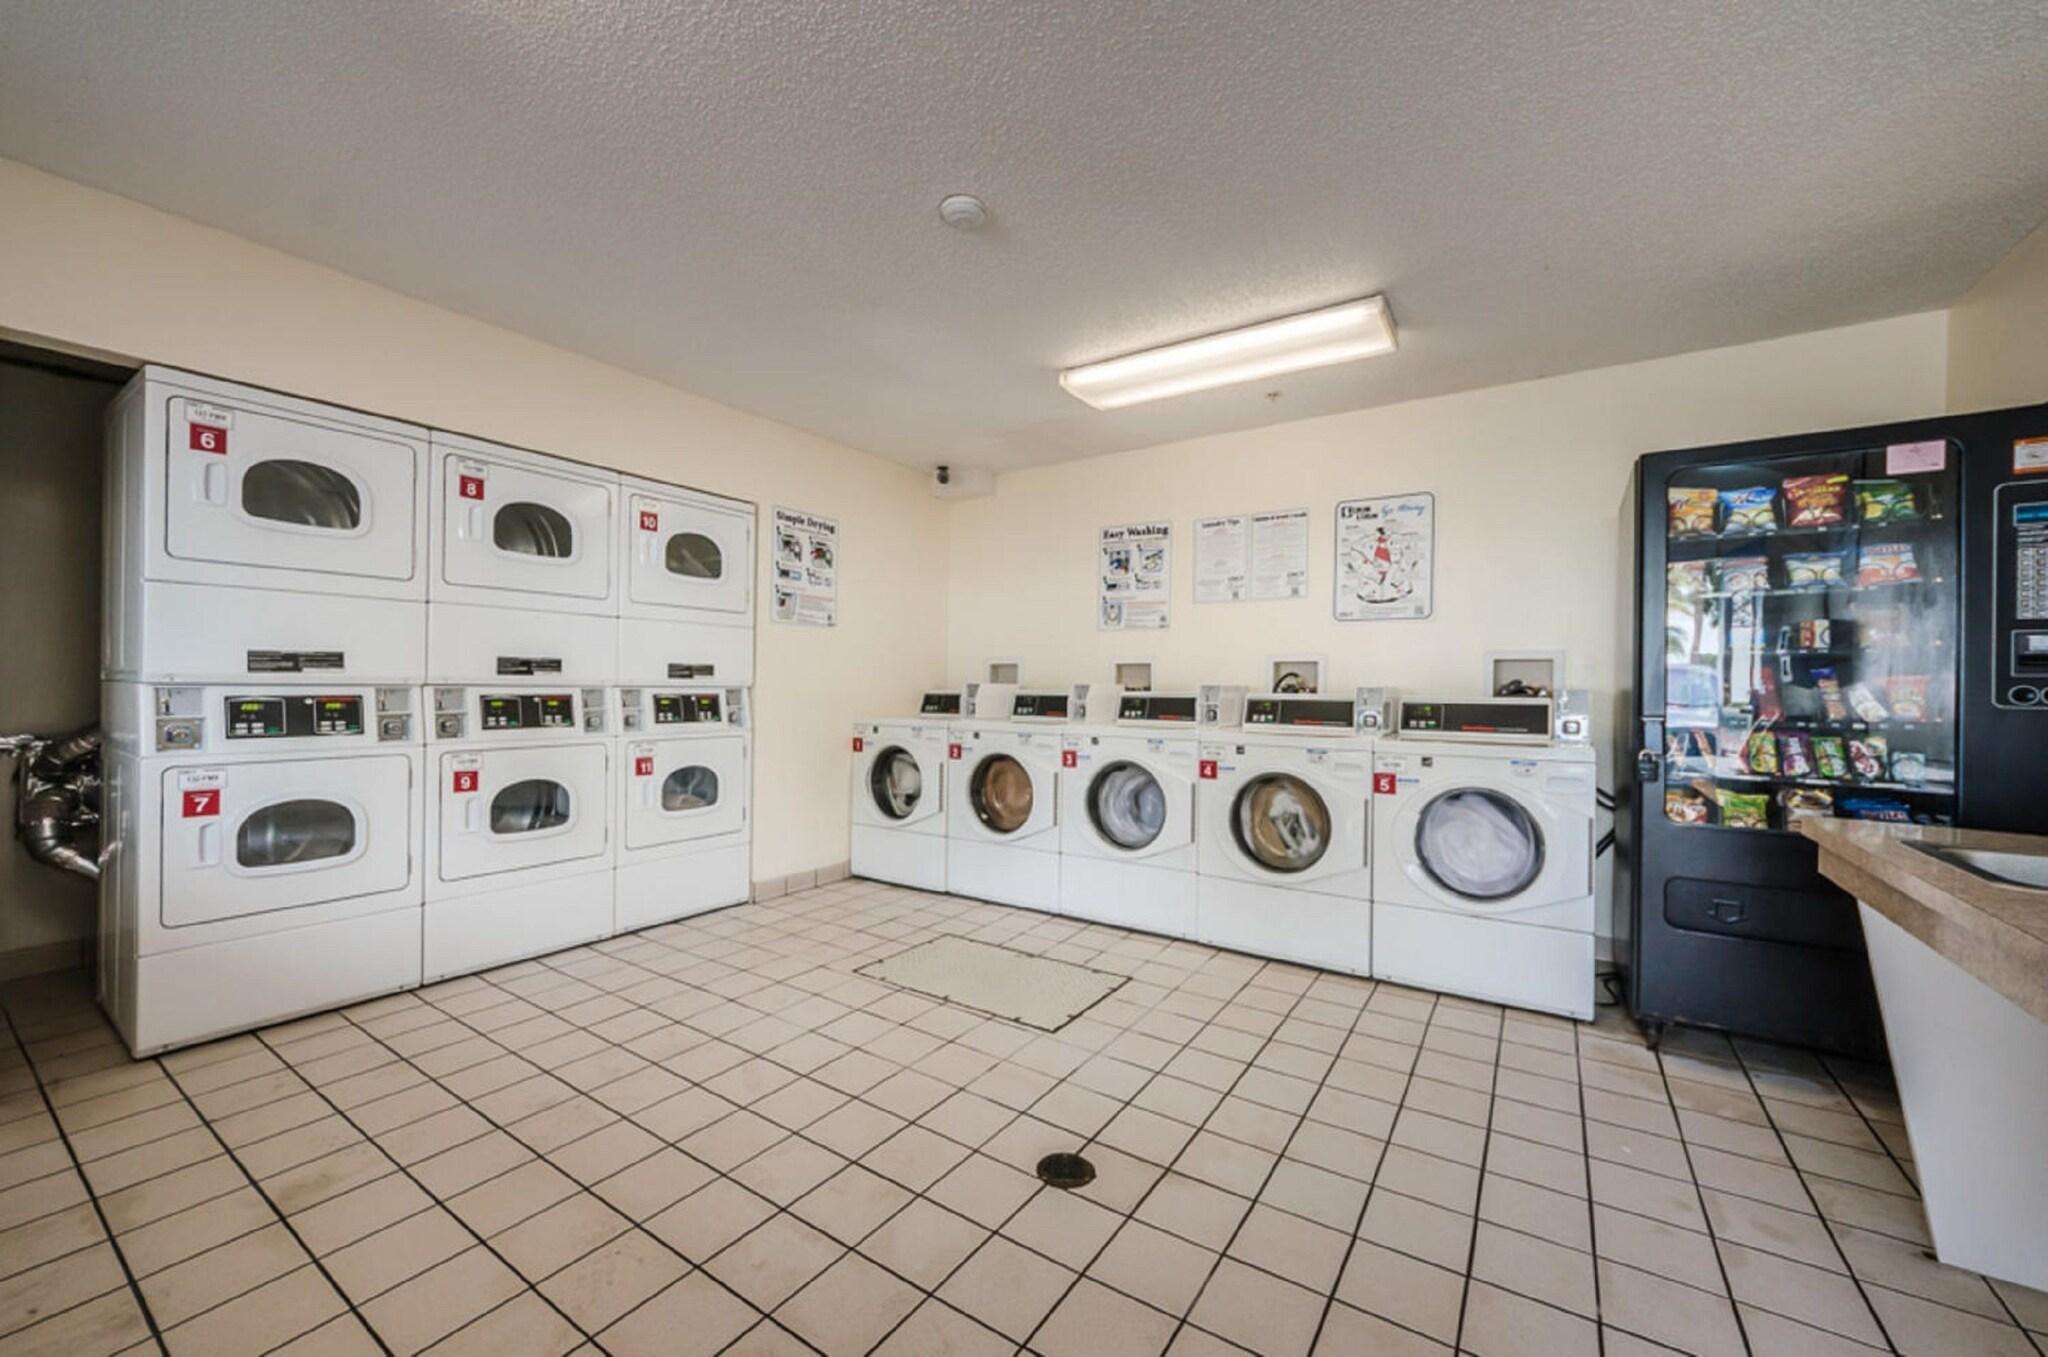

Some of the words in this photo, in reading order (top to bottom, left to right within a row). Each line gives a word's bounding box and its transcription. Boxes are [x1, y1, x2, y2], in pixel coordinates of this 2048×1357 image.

[200, 432, 216, 449] 6
[466, 483, 477, 497] 8
[643, 516, 656, 529] 10
[776, 510, 805, 526] Simple
[807, 517, 836, 535] Drying
[1103, 530, 1125, 540] Easy
[1126, 525, 1169, 537] Washing
[641, 762, 652, 773] 11
[1203, 765, 1213, 777] 4
[460, 776, 471, 790] 9
[1380, 779, 1391, 792] 5
[194, 797, 210, 813] 7
